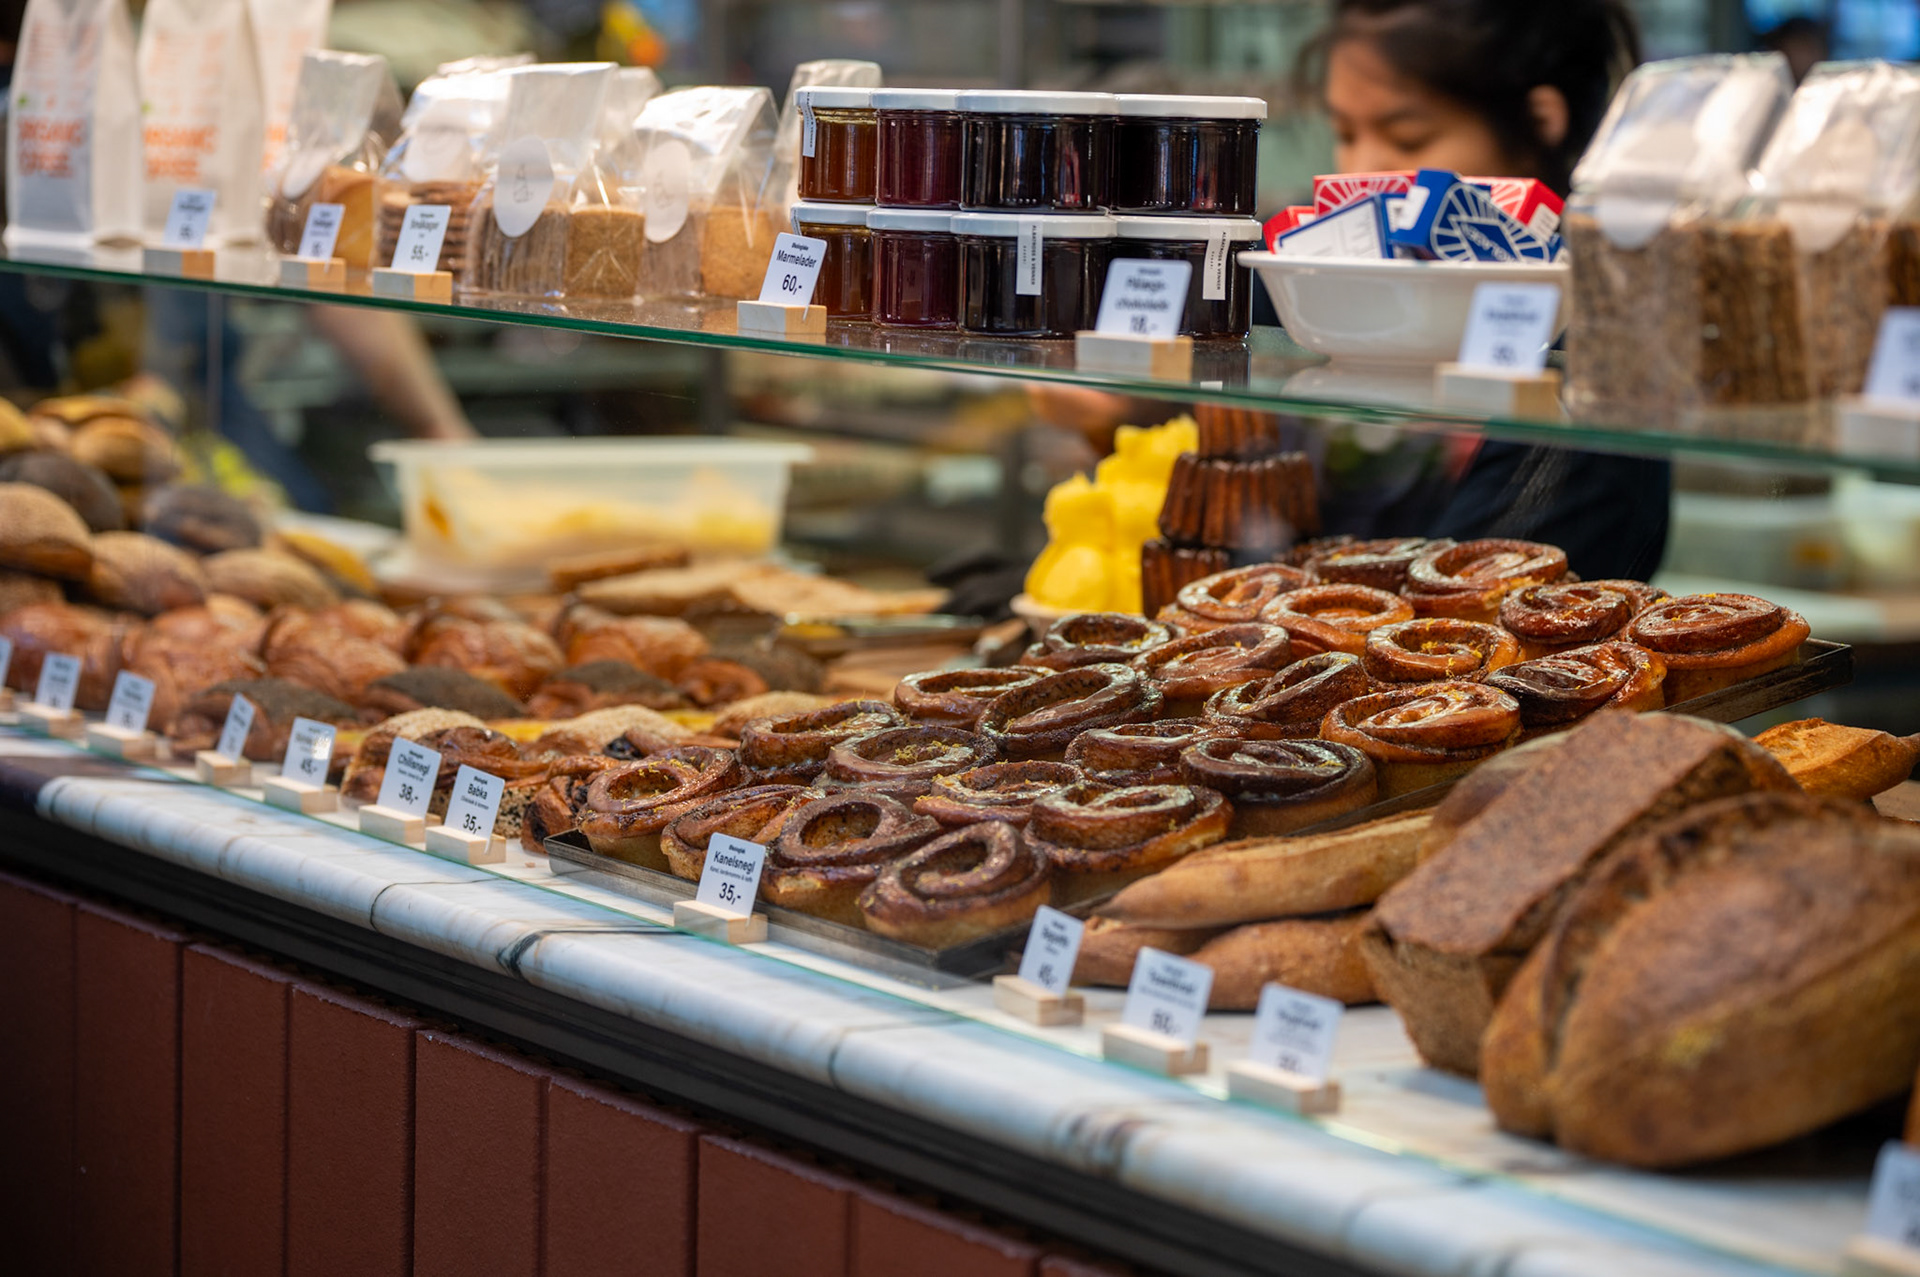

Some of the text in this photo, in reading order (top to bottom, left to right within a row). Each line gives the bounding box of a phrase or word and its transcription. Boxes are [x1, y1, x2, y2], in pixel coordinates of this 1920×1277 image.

[1217, 231, 1227, 261] ALBATROSS
[776, 250, 817, 269] Marmelader
[782, 274, 802, 294] 60,-
[399, 783, 418, 805] 38,-
[467, 783, 488, 800] Babka
[462, 813, 482, 834] 35,-
[714, 851, 756, 875] Kanelsnegl
[719, 882, 742, 905] 35,-
